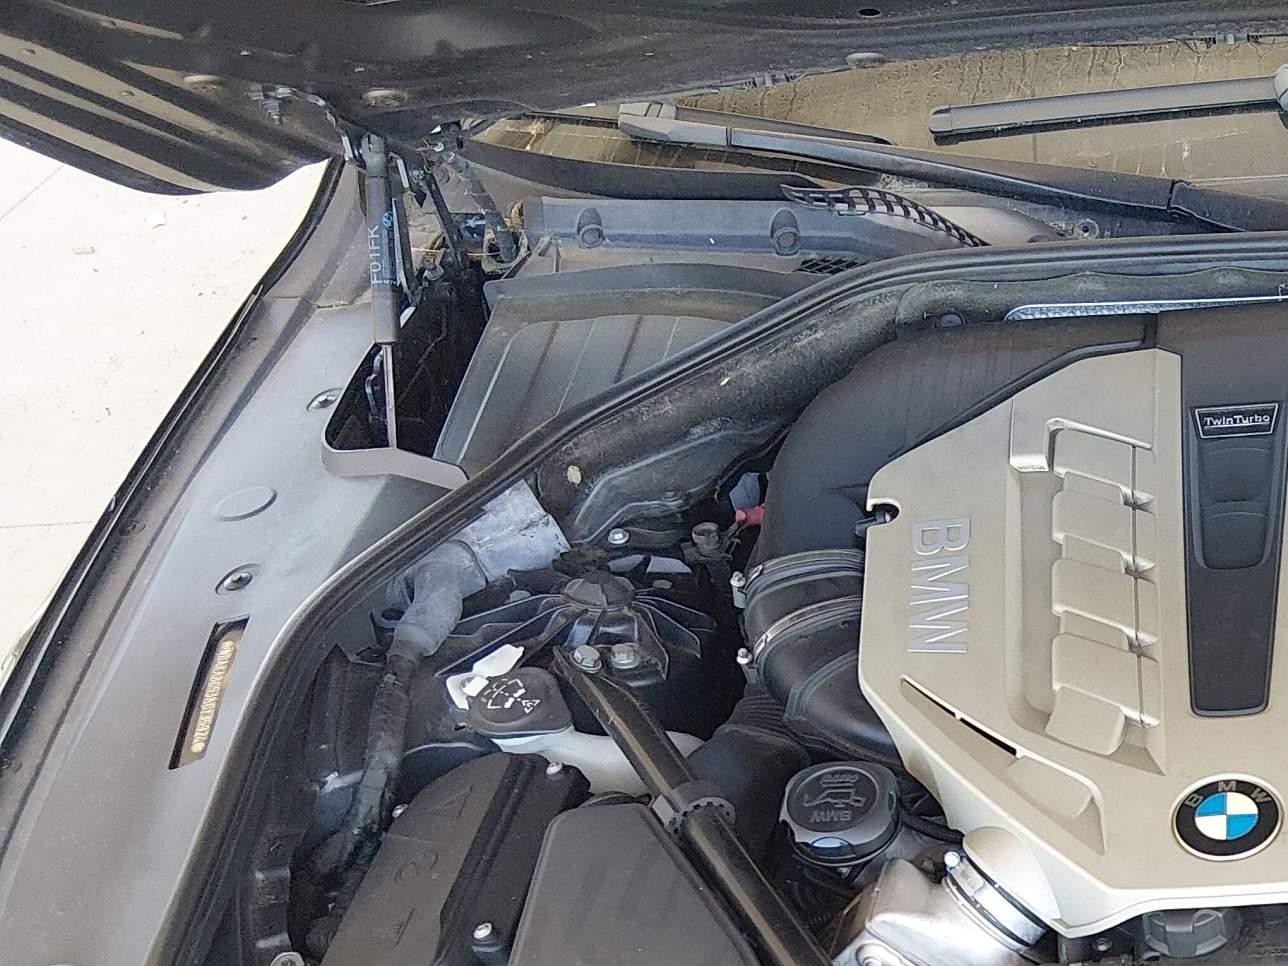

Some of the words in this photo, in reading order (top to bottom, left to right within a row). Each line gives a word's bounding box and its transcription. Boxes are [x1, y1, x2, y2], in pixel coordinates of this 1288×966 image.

[368, 225, 382, 285] F01FK
[1204, 414, 1271, 427] TwinTurbo
[908, 516, 970, 653] BMW
[1184, 780, 1272, 808] BMW
[810, 810, 852, 822] BMW
